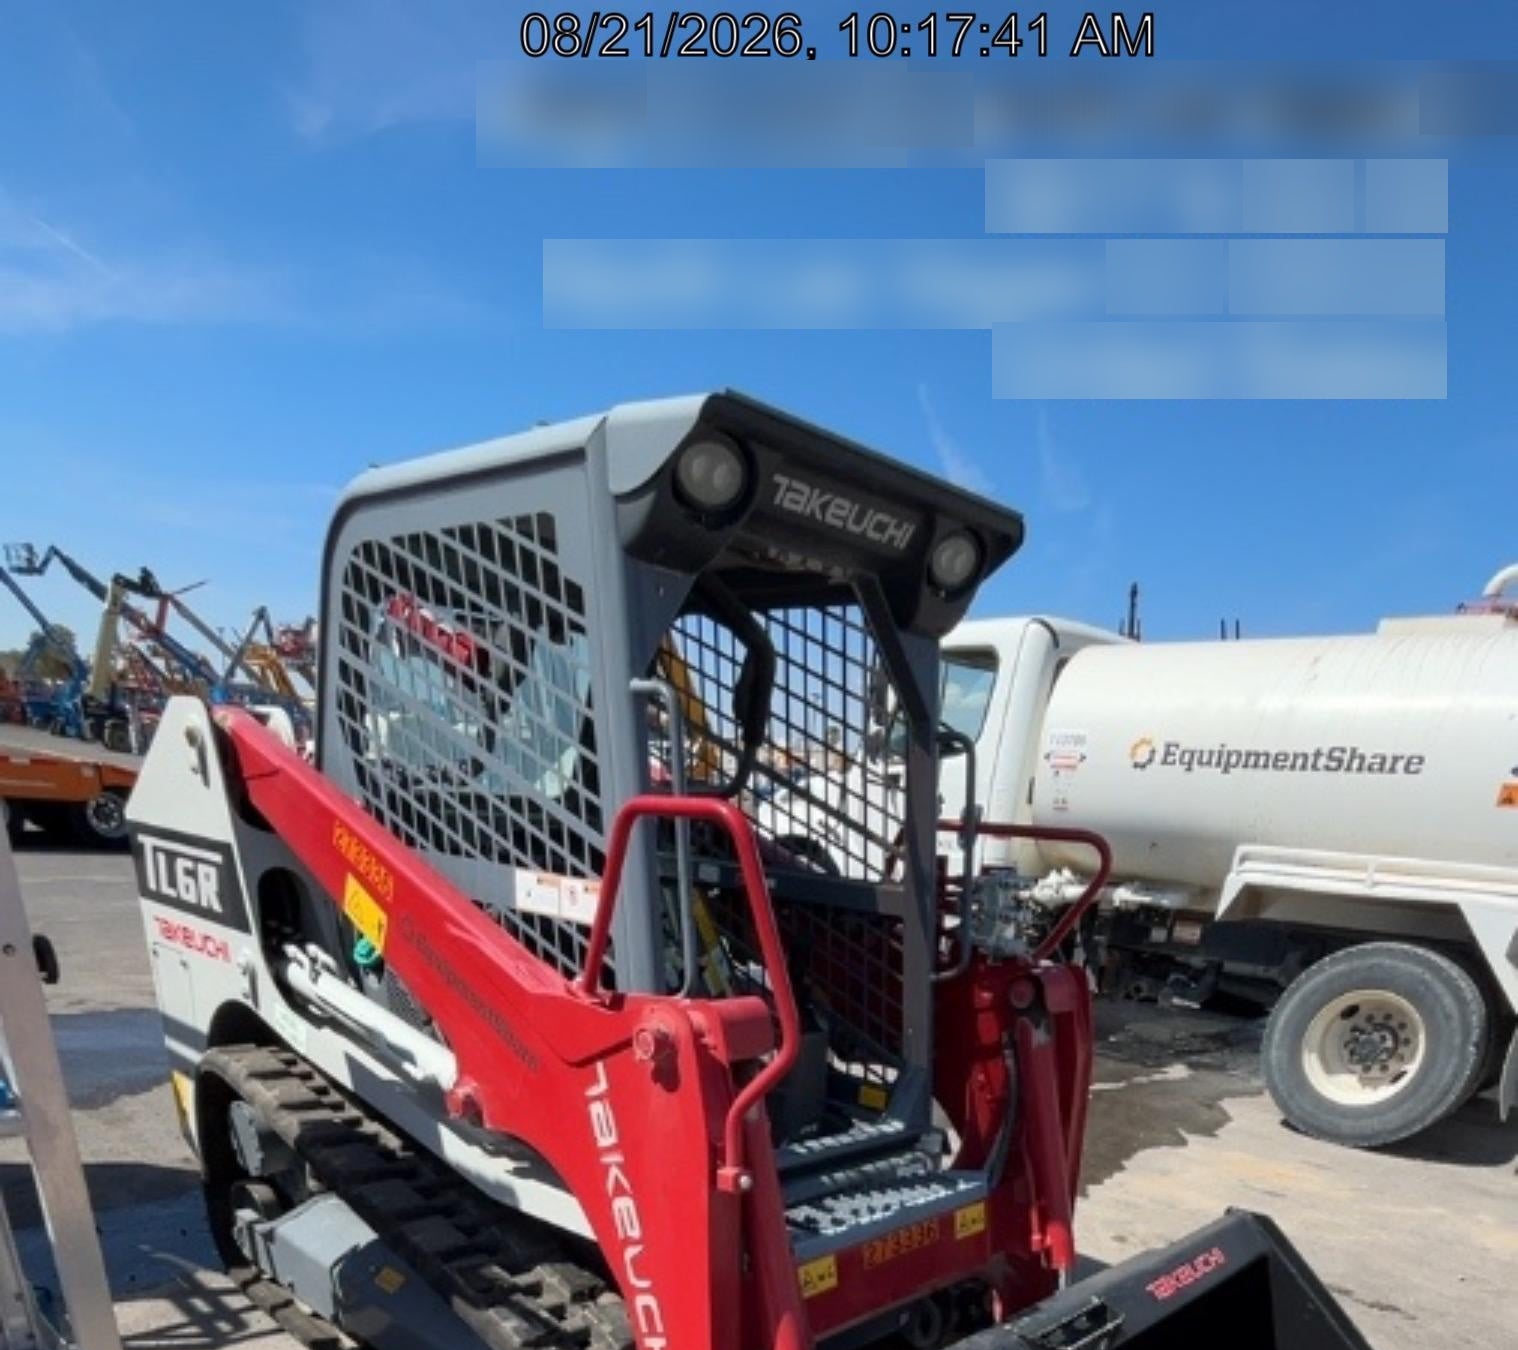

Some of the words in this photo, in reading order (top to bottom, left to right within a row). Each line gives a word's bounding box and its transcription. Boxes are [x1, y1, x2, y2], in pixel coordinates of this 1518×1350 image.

[772, 473, 916, 550] TAKEUCHI
[1160, 742, 1425, 775] EquipmentShare
[137, 833, 223, 913] TL6R
